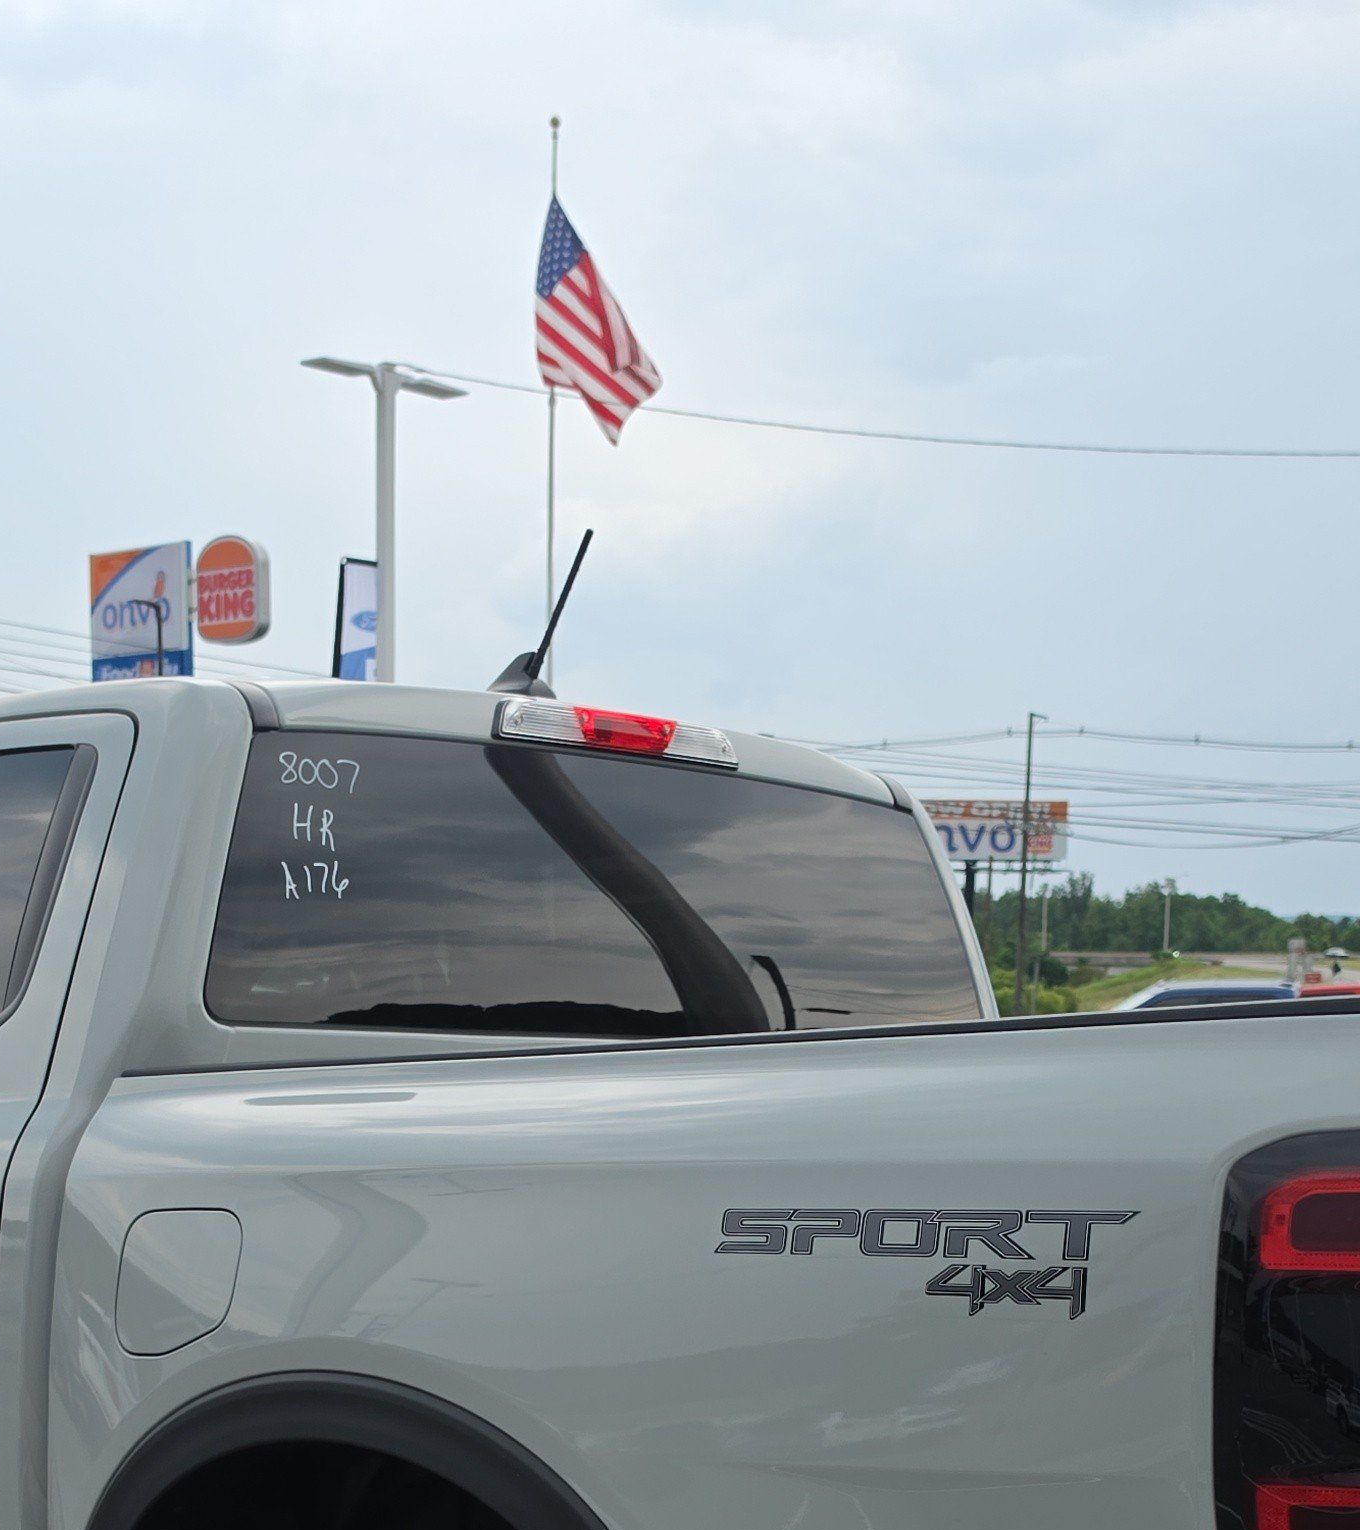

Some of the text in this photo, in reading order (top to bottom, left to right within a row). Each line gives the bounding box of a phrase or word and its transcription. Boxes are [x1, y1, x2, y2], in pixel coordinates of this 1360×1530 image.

[199, 568, 254, 594] BURGER
[199, 589, 254, 622] KING
[278, 751, 360, 793] 8007
[935, 821, 1016, 853] nvo
[280, 860, 350, 900] A176
[714, 1208, 1142, 1262] SPORT
